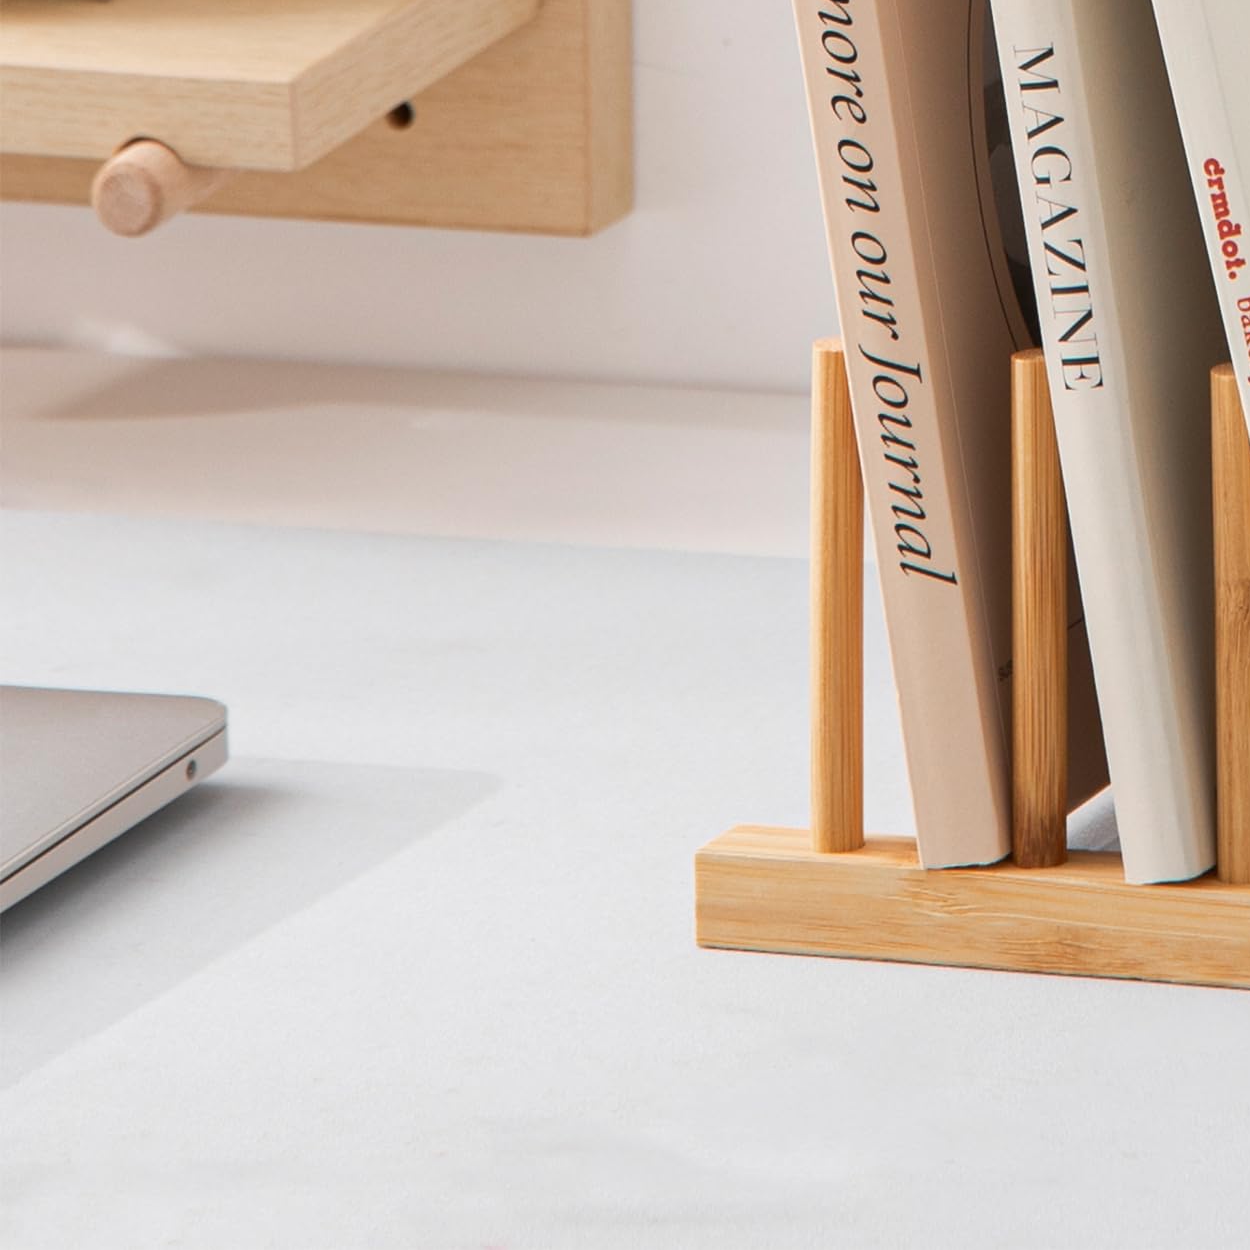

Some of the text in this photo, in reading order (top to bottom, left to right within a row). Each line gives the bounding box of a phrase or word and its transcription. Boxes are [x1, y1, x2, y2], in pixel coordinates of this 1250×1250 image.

[838, 138, 881, 213] on
[1013, 42, 1105, 391] MAGAZINE
[850, 231, 900, 342] our
[858, 343, 958, 586] Journal
